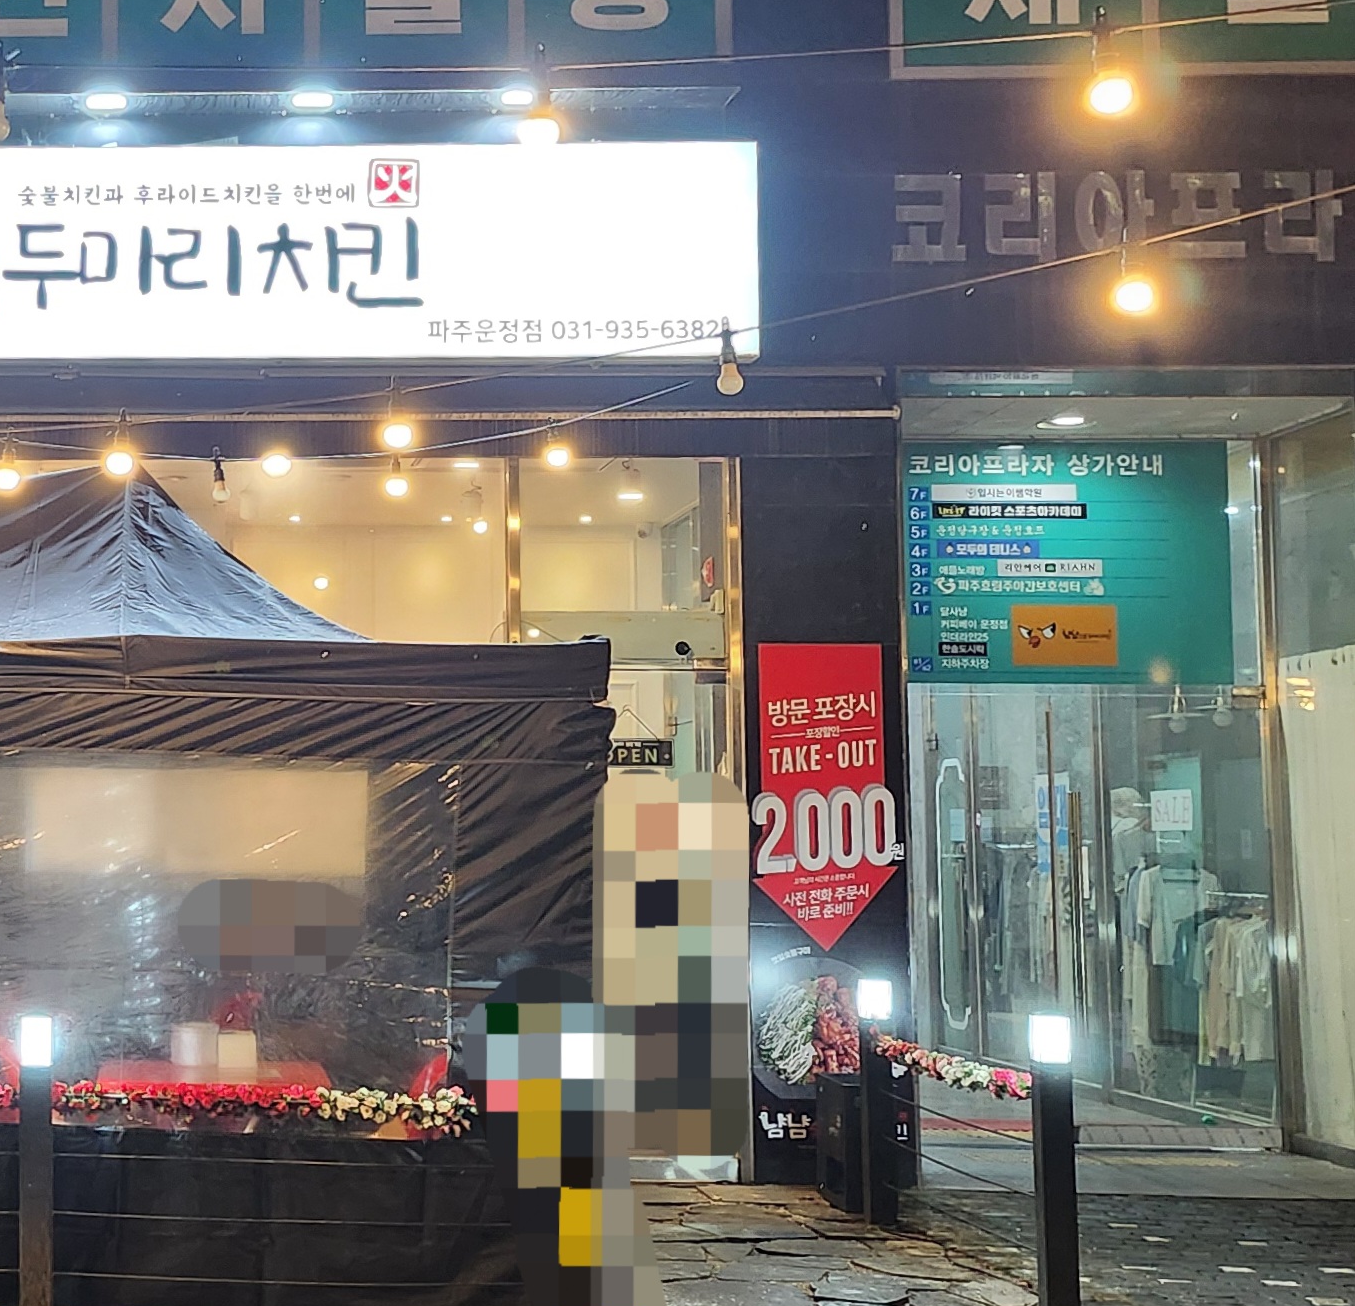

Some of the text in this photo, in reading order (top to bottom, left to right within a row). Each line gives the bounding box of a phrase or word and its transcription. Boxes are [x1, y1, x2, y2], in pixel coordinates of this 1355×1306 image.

[18, 183, 355, 207] 숯불치킨과 후라이드치킨을 한번에
[428, 319, 721, 343] 파주운정점 031-935-6382
[908, 454, 1163, 476] 코리아프라자 상가안내
[910, 488, 927, 500] 7F
[910, 507, 927, 519] 6F
[910, 526, 927, 538] 5F
[910, 544, 1021, 557] 4F 모두의 테니스
[911, 564, 927, 575] 3F
[1060, 563, 1095, 572] RIAHN
[912, 583, 929, 594] 2F
[913, 602, 929, 614] 1F
[768, 691, 876, 727] 방문 포장시
[1154, 796, 1190, 824] SALE
[782, 883, 870, 908] 사전 전화 주문시
[797, 901, 854, 922] 바로 준비!!
